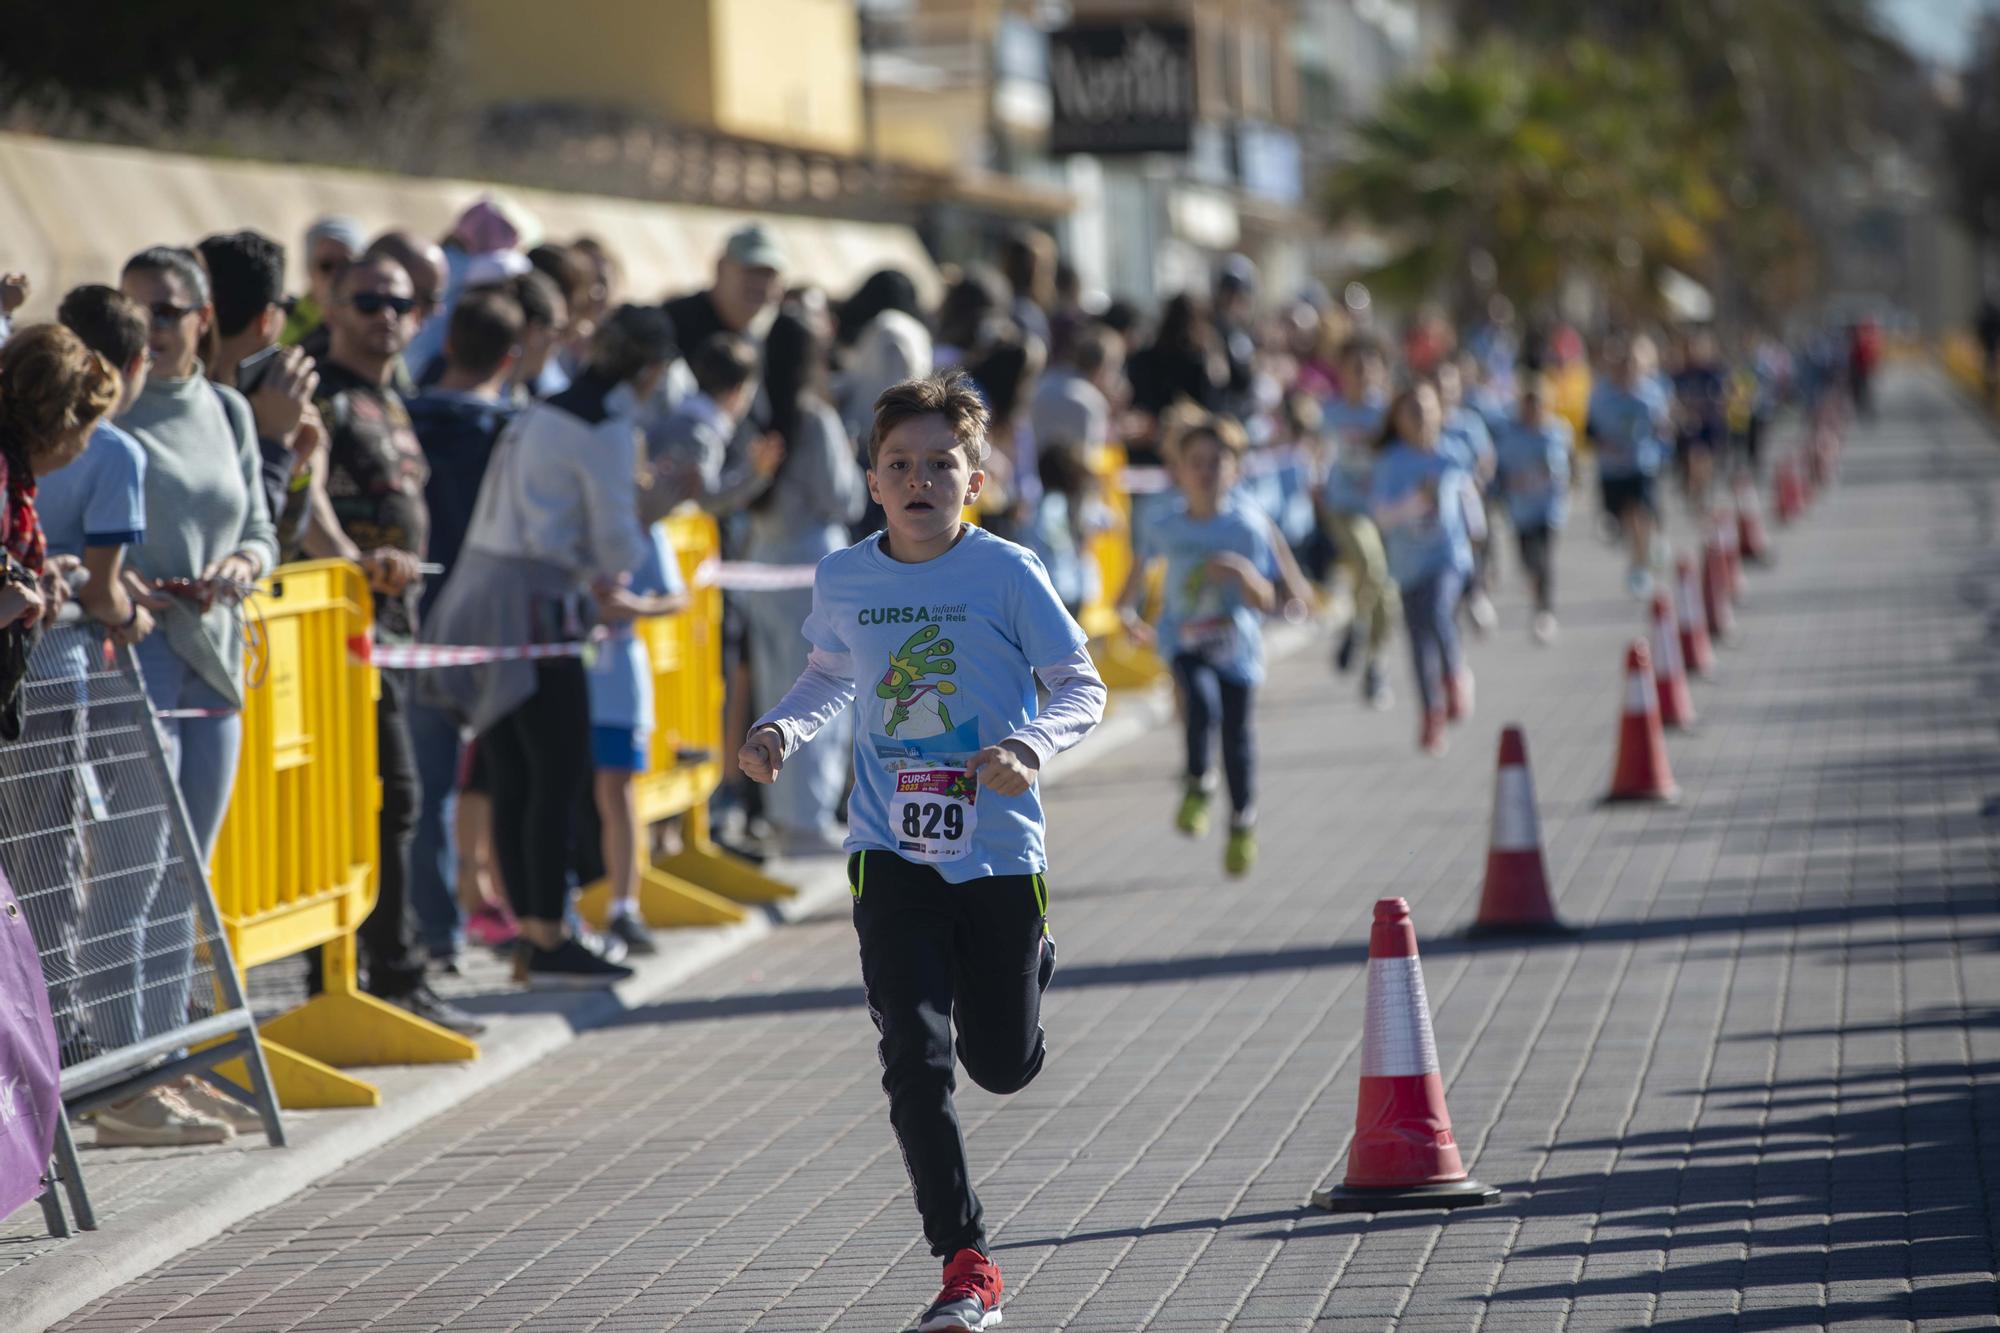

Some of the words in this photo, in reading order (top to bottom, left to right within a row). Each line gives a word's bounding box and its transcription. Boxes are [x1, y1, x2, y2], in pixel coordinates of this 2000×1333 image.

[931, 603, 967, 614] infantil
[858, 606, 930, 625] CURSA
[931, 614, 943, 622] de
[946, 614, 967, 622] Reis
[901, 774, 931, 784] CURSA
[900, 783, 919, 791] 2023
[902, 802, 964, 841] 829
